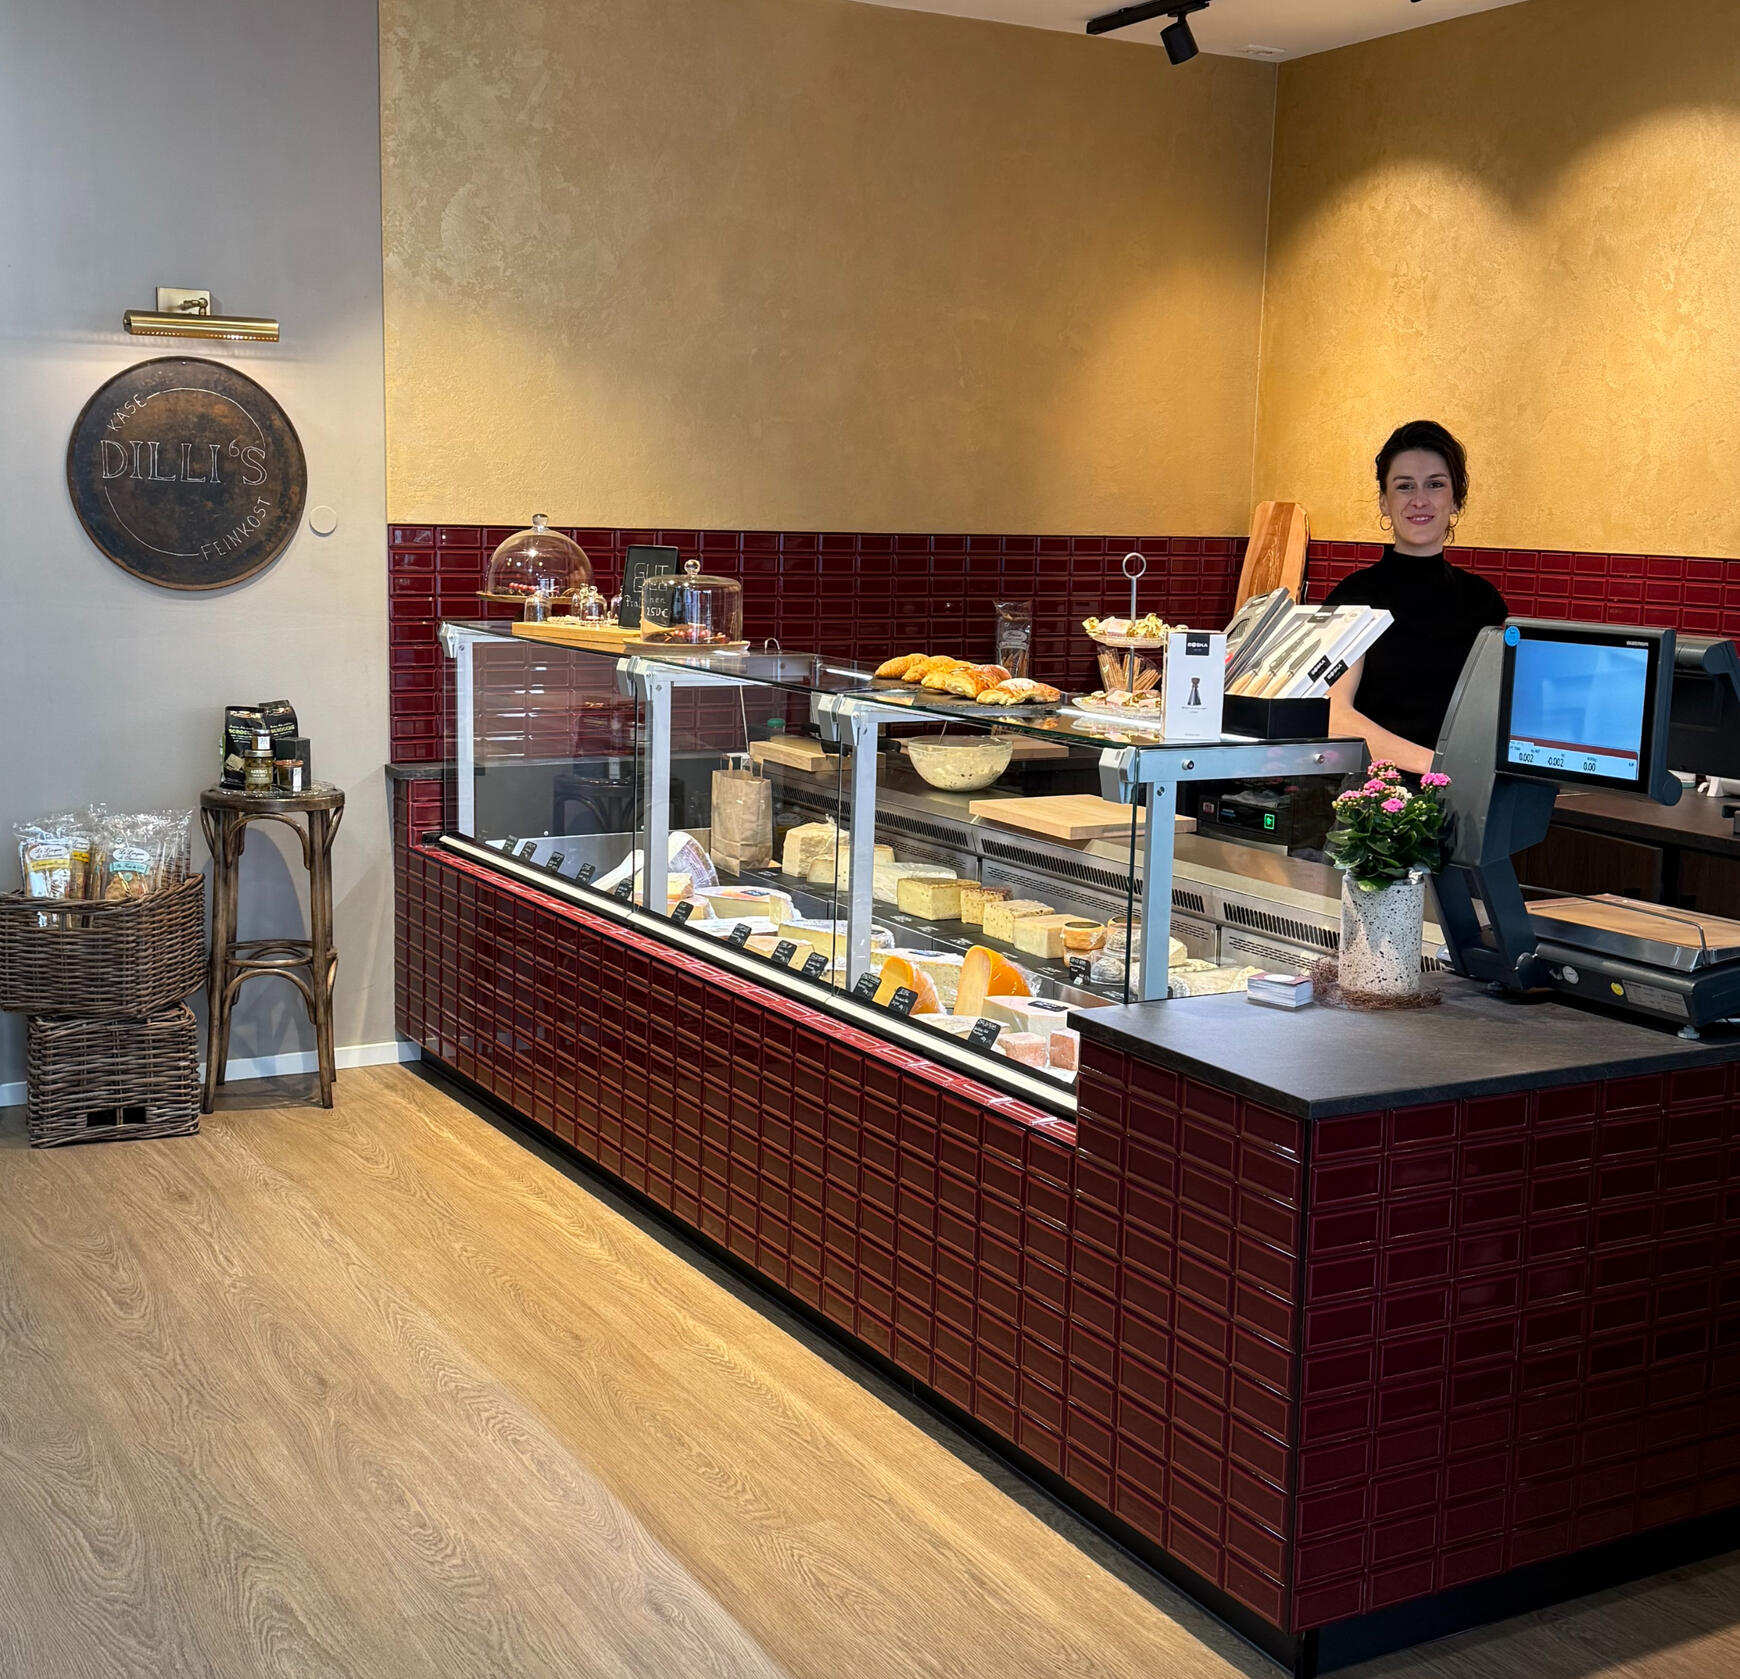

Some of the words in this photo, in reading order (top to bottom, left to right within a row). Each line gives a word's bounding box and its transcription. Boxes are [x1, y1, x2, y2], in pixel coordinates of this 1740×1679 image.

[106, 393, 147, 432] KÄSE
[200, 496, 272, 561] FEINKOST
[1583, 761, 1597, 772] 0.00
